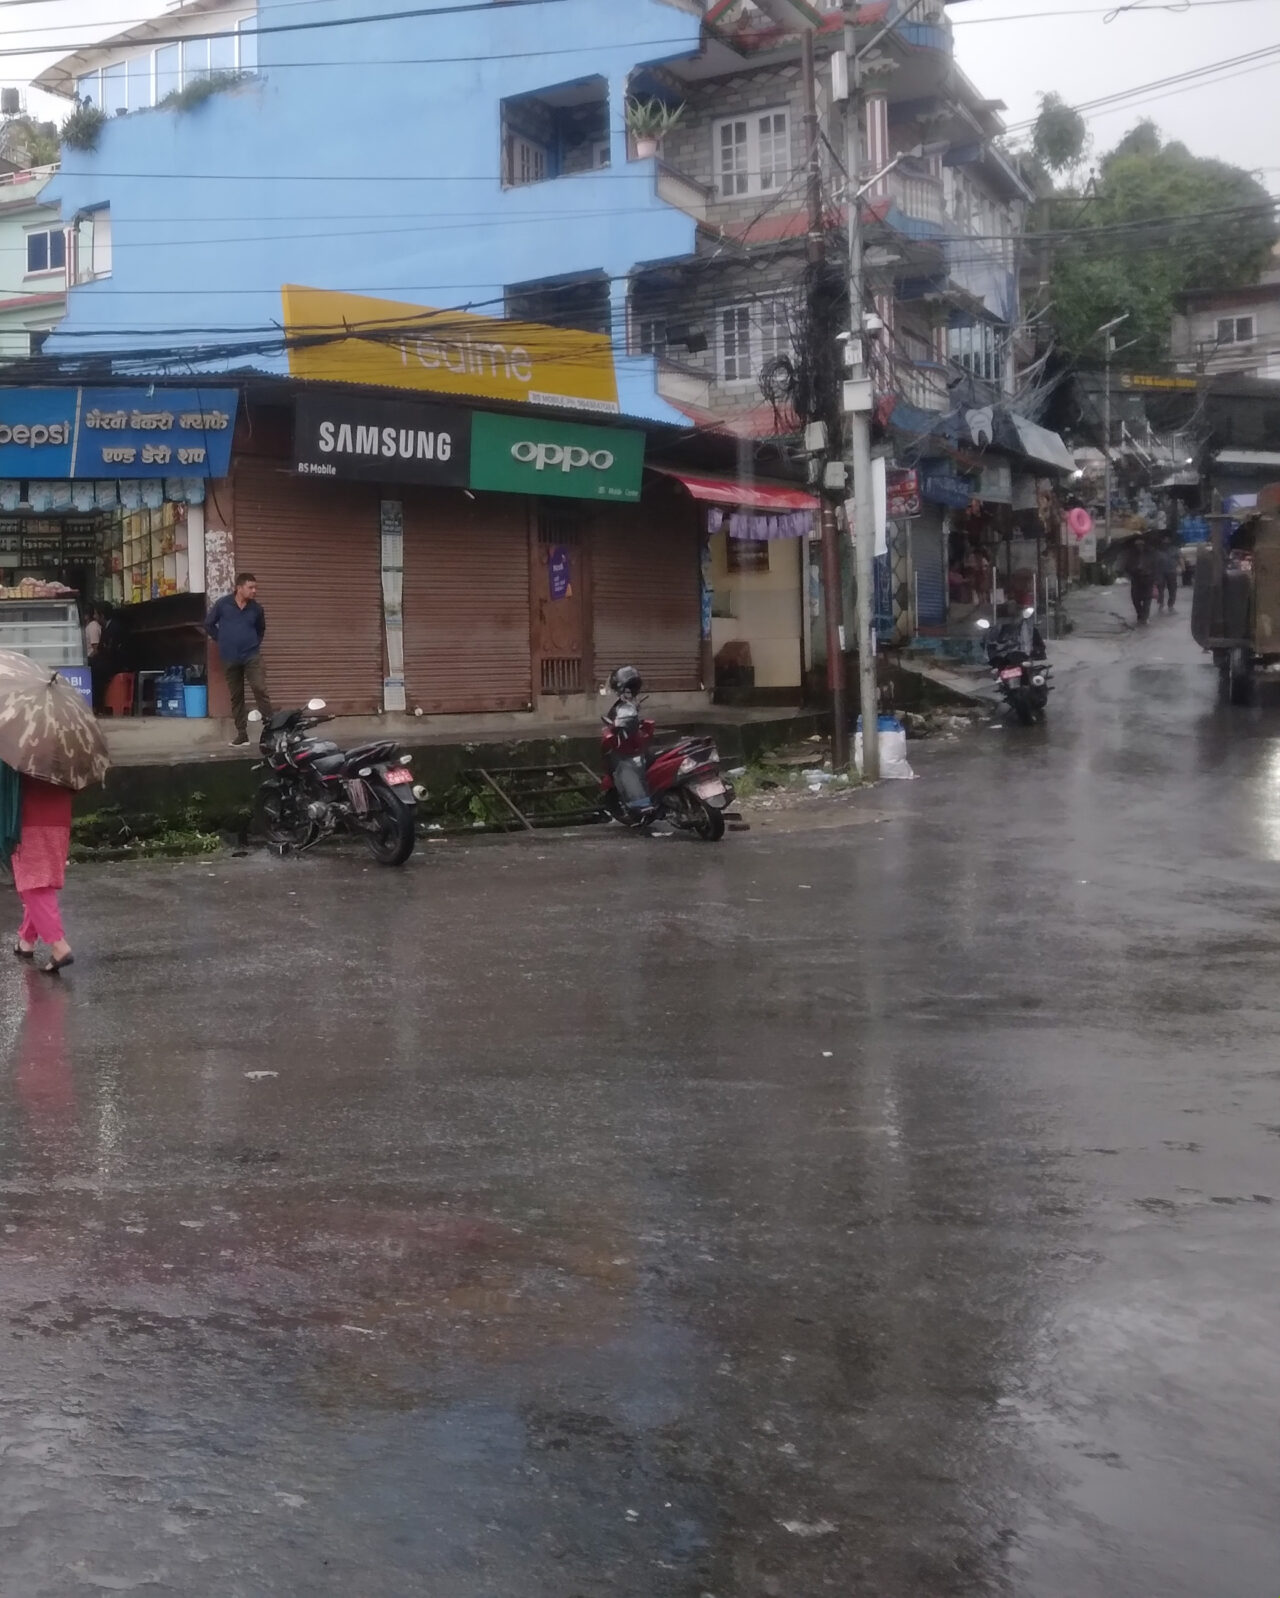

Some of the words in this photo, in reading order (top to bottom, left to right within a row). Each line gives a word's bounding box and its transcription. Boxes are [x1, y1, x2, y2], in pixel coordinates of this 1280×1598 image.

[399, 333, 533, 382] realme
[85, 408, 128, 429] भैरवी
[130, 409, 175, 430] बेकरी
[318, 421, 452, 461] SAMSUNG
[102, 447, 137, 463] एण्ड
[141, 444, 171, 464] डेरी
[177, 448, 206, 464] शप
[298, 462, 309, 474] BS
[310, 463, 337, 475] Mobile
